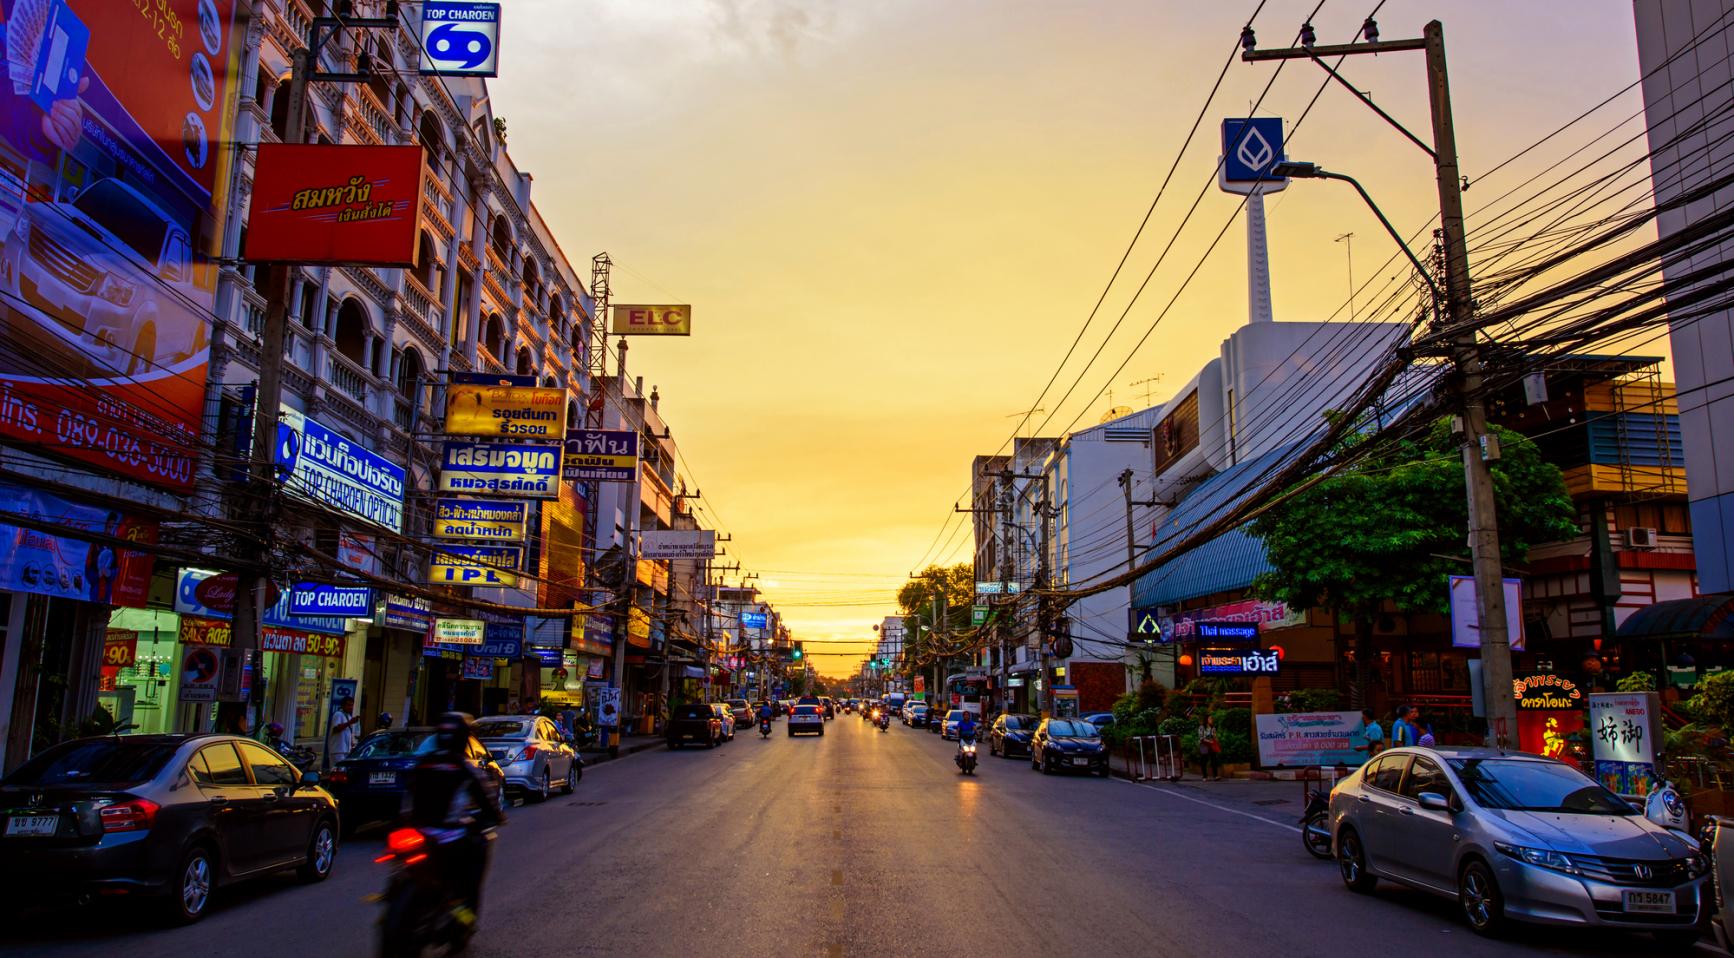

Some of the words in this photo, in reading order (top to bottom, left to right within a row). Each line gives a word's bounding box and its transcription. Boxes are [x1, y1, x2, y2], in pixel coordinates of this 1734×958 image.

[426, 9, 447, 19] TOP
[448, 10, 495, 20] CHAROEN
[292, 176, 371, 210] สมหวัง
[338, 201, 393, 222] เงินสั่งได้
[629, 310, 682, 326] ELC
[501, 419, 547, 435] ริ้วรอย
[566, 433, 628, 454] าฟัน
[448, 444, 555, 474] เสริมจมูก
[303, 465, 323, 498] TOP
[450, 476, 550, 493] หมอสุรศักดิ์
[445, 522, 512, 537] ลดน้ำหนัก
[295, 591, 315, 606] TOP
[317, 592, 367, 607] CHAROEN
[1200, 625, 1218, 636] Thai
[1219, 626, 1256, 638] massage
[1242, 650, 1279, 672] เฮ้าส์
[1521, 692, 1573, 708] คาราโอเกะ
[1645, 892, 1671, 905] 5847
